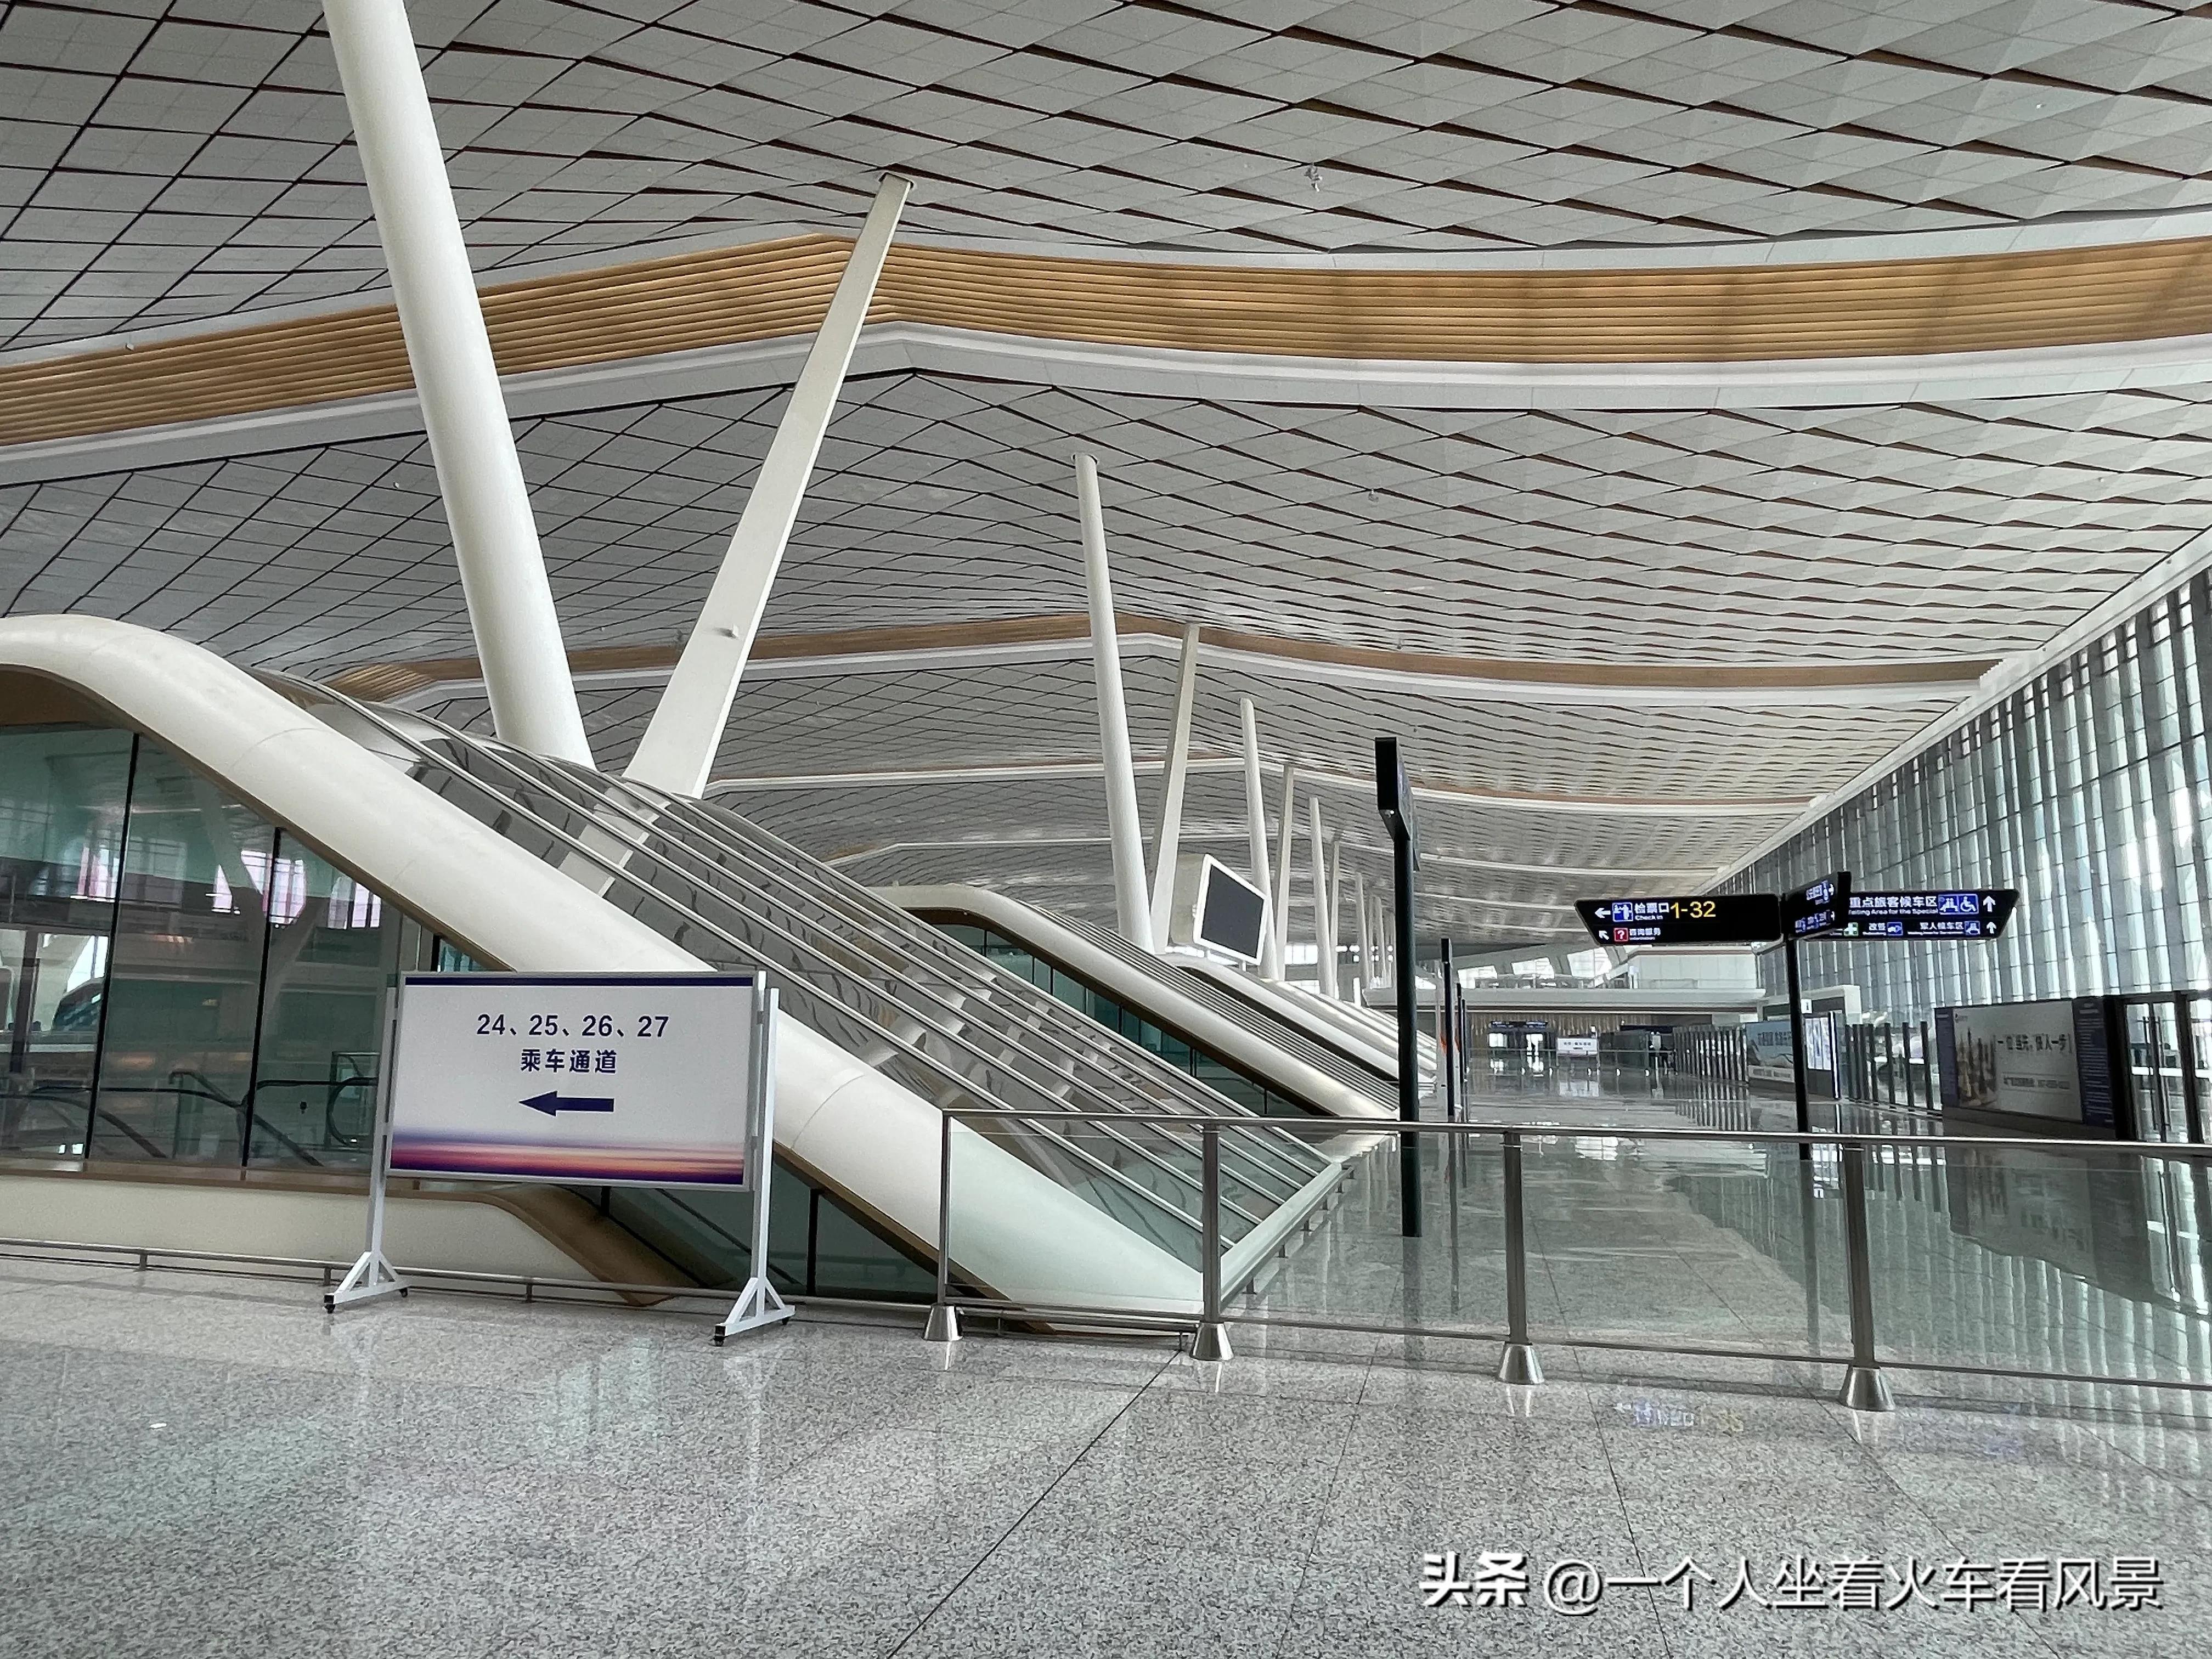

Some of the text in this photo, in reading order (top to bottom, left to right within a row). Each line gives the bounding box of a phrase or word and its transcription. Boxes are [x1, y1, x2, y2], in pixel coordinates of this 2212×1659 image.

[1635, 901, 1716, 919] 检票口 1-32
[1849, 896, 1938, 908] 重点旅客候车区
[521, 1048, 617, 1074] 乘车通道
